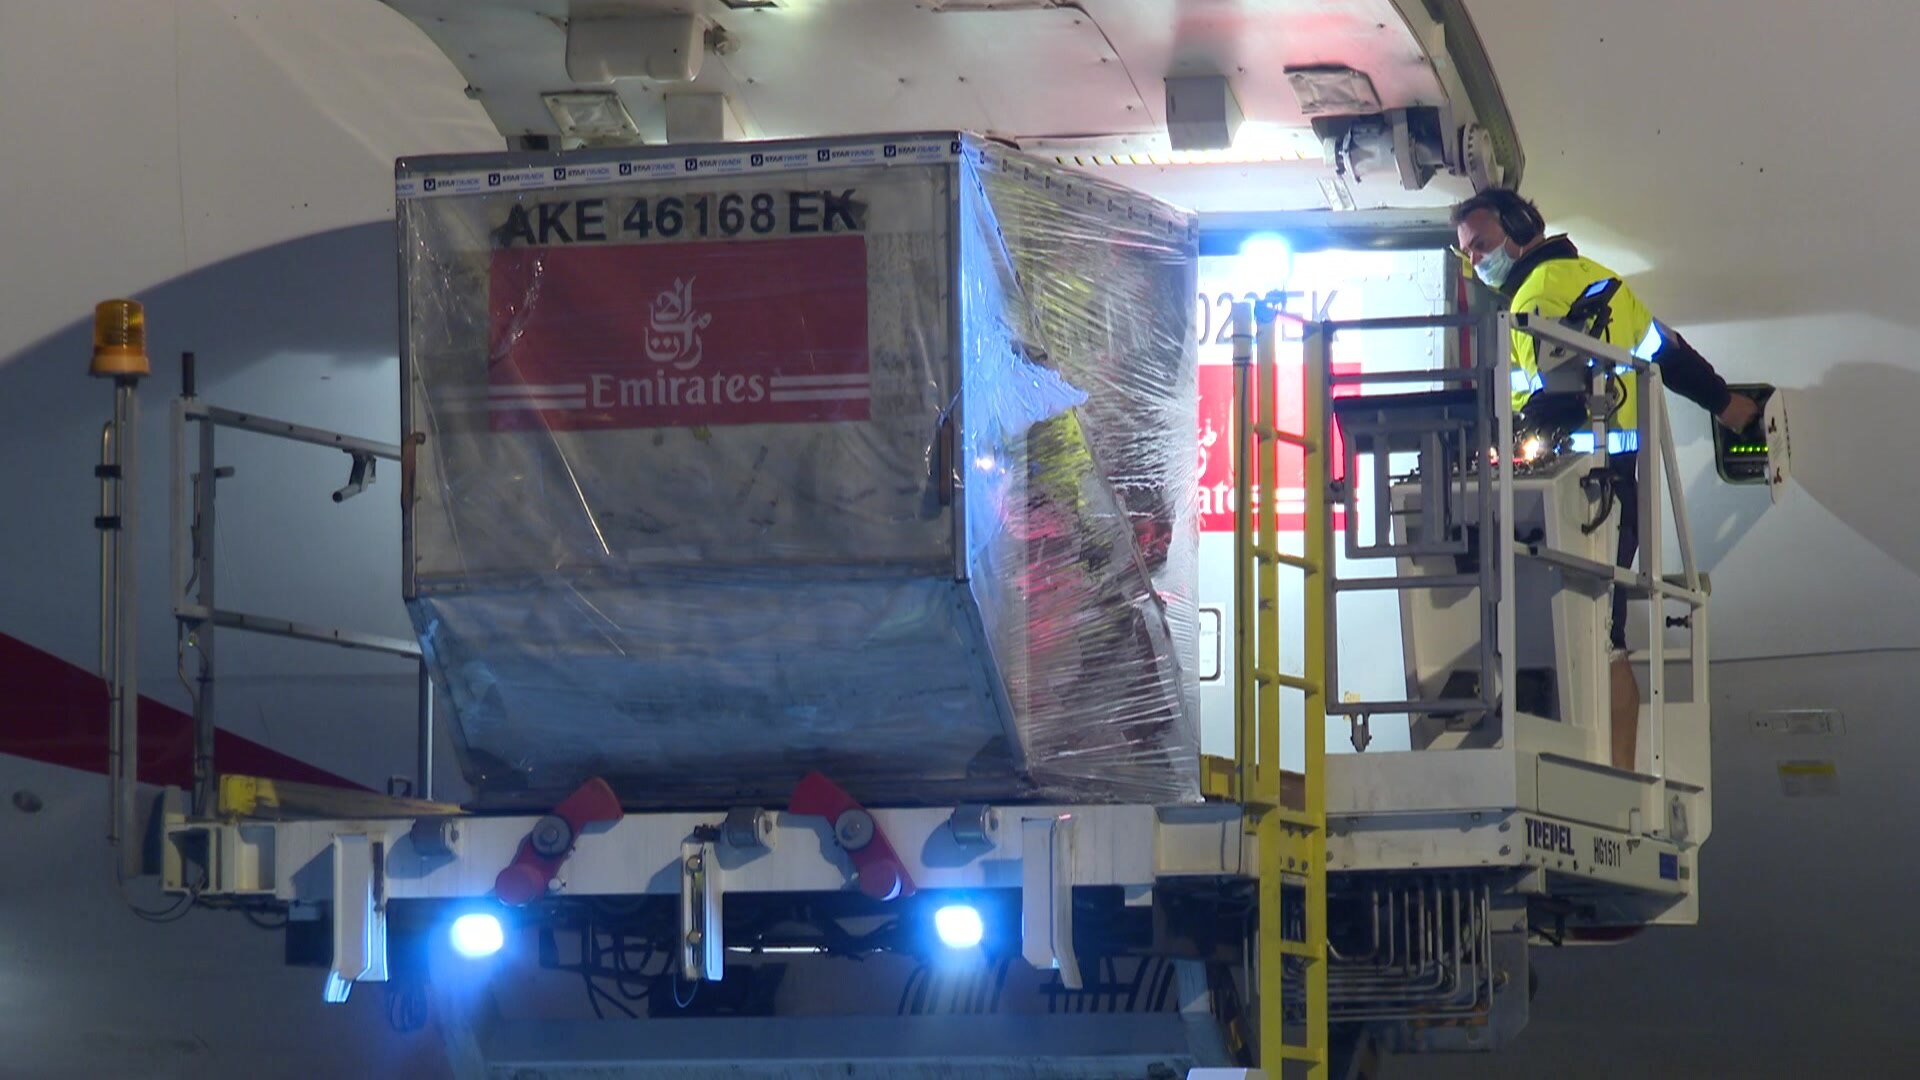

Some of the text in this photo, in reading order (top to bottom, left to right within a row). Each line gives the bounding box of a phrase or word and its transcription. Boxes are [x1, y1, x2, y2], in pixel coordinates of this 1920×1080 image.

[504, 188, 858, 246] AKE 46168 EK
[589, 369, 765, 410] Emirates
[1525, 817, 1575, 856] TREPEL
[1593, 836, 1622, 868] HG1511
